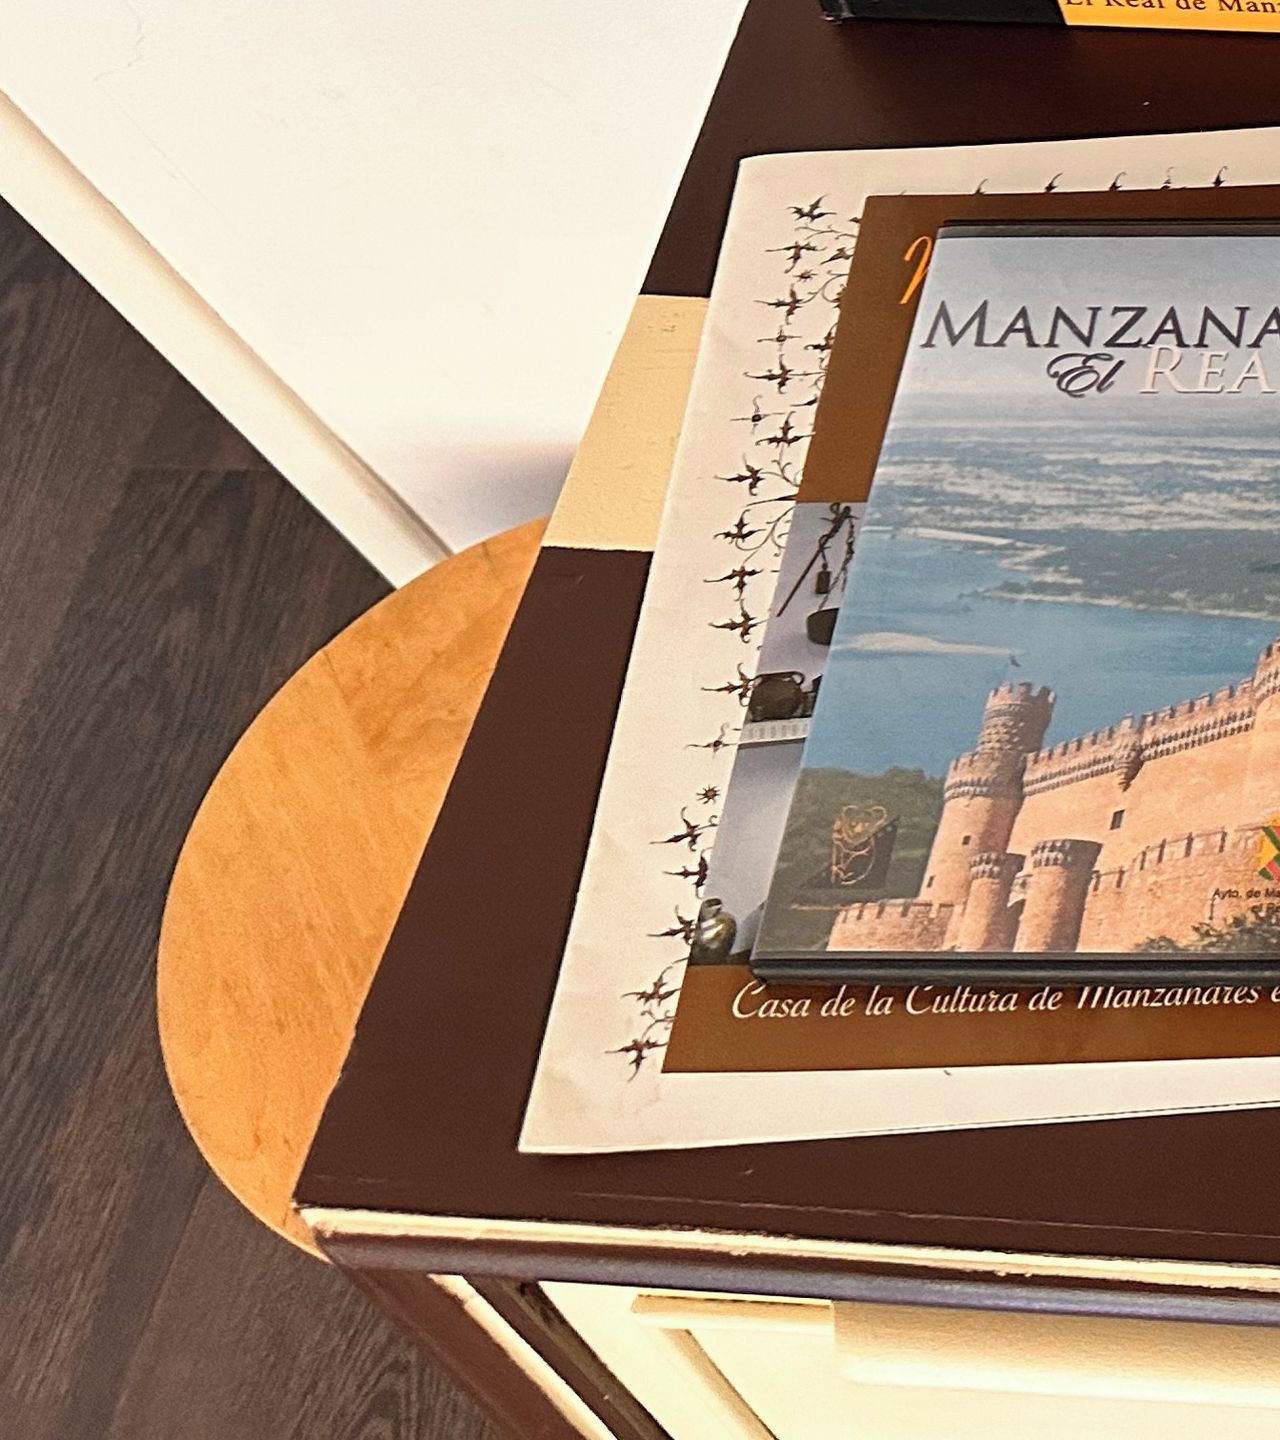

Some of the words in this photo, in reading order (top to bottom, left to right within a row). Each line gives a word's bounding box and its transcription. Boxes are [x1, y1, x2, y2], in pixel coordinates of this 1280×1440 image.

[1045, 351, 1127, 399] El
[731, 979, 811, 1020] Casa
[820, 988, 856, 1018] de
[865, 987, 894, 1017] la
[904, 984, 1017, 1016] Cultura
[1027, 986, 1064, 1013] de
